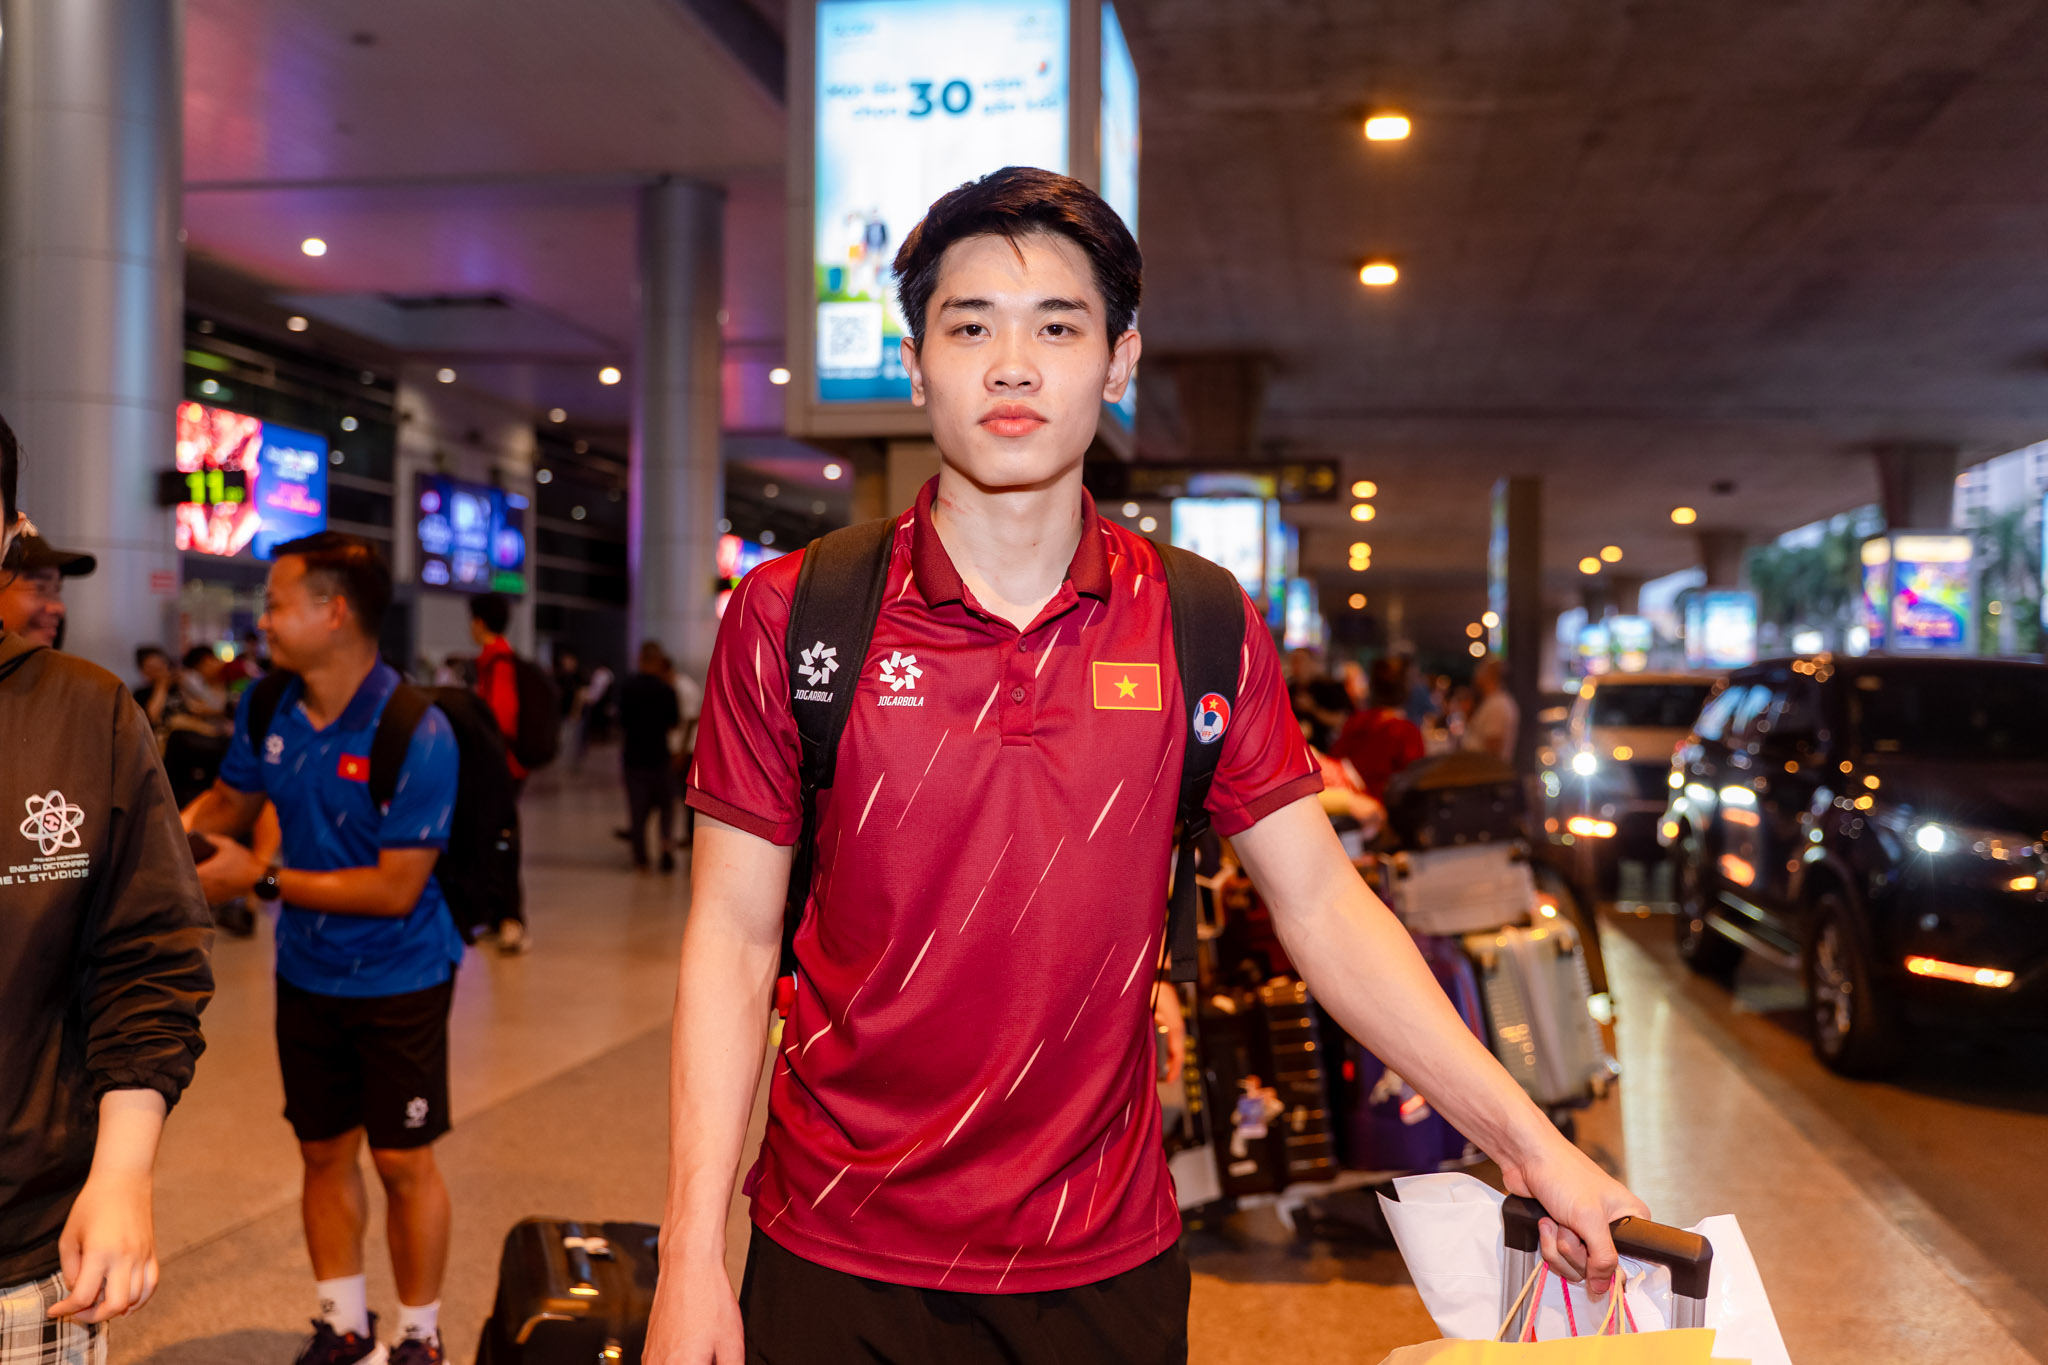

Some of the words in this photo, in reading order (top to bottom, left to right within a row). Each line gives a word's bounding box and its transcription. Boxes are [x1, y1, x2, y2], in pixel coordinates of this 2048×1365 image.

[907, 79, 973, 117] 30
[794, 689, 834, 703] JOGARBOLA
[877, 695, 925, 707] JOGARBOLA
[1201, 730, 1213, 738] VFF
[9, 863, 42, 874] ENGLISH
[42, 859, 90, 871] DICTIONARY
[17, 874, 26, 884] L
[29, 868, 89, 883] STUDIOS
